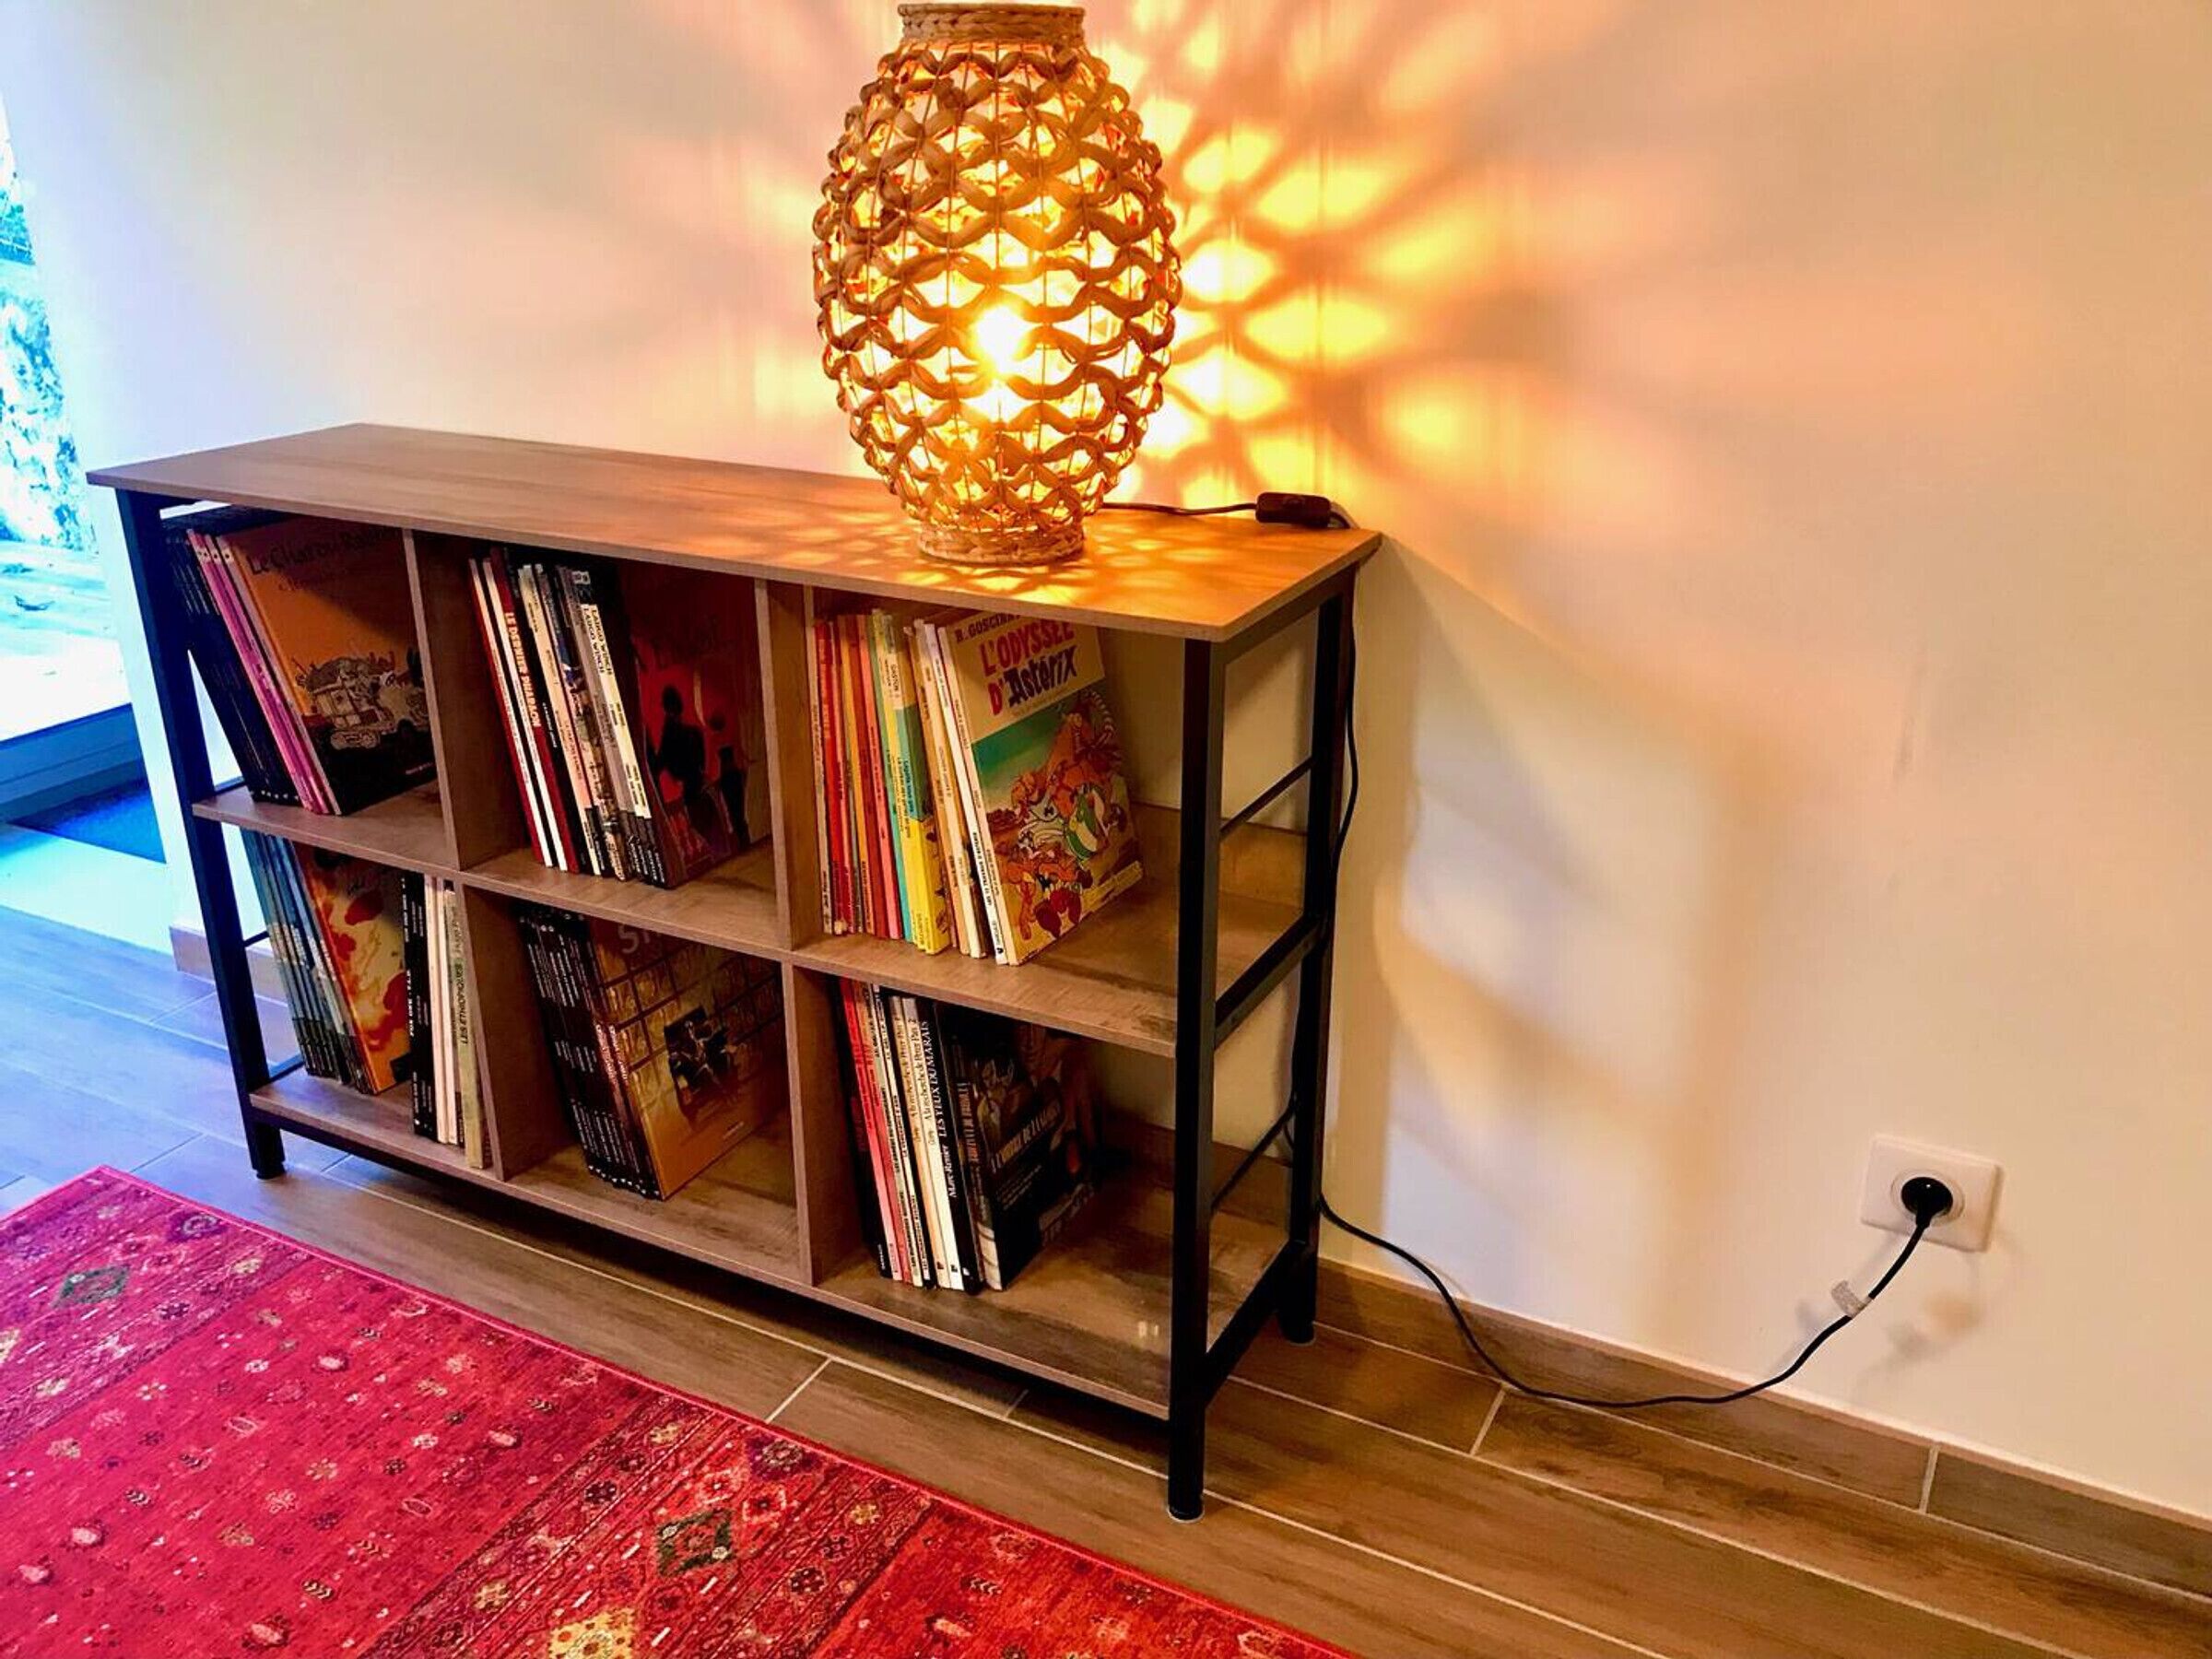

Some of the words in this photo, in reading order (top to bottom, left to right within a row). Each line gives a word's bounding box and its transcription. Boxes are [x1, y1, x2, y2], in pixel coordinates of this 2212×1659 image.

[505, 612, 516, 625] LE
[583, 608, 595, 640] LARGO
[593, 641, 605, 673] WINCH
[592, 609, 603, 641] LARGO
[600, 644, 613, 675] WINCH
[508, 626, 528, 674] DERNIER
[521, 676, 541, 727] PHARAON
[921, 1020, 936, 1067] MARAIS
[929, 1067, 938, 1085] DU
[932, 1087, 943, 1116] YEUX
[936, 1118, 947, 1138] LES
